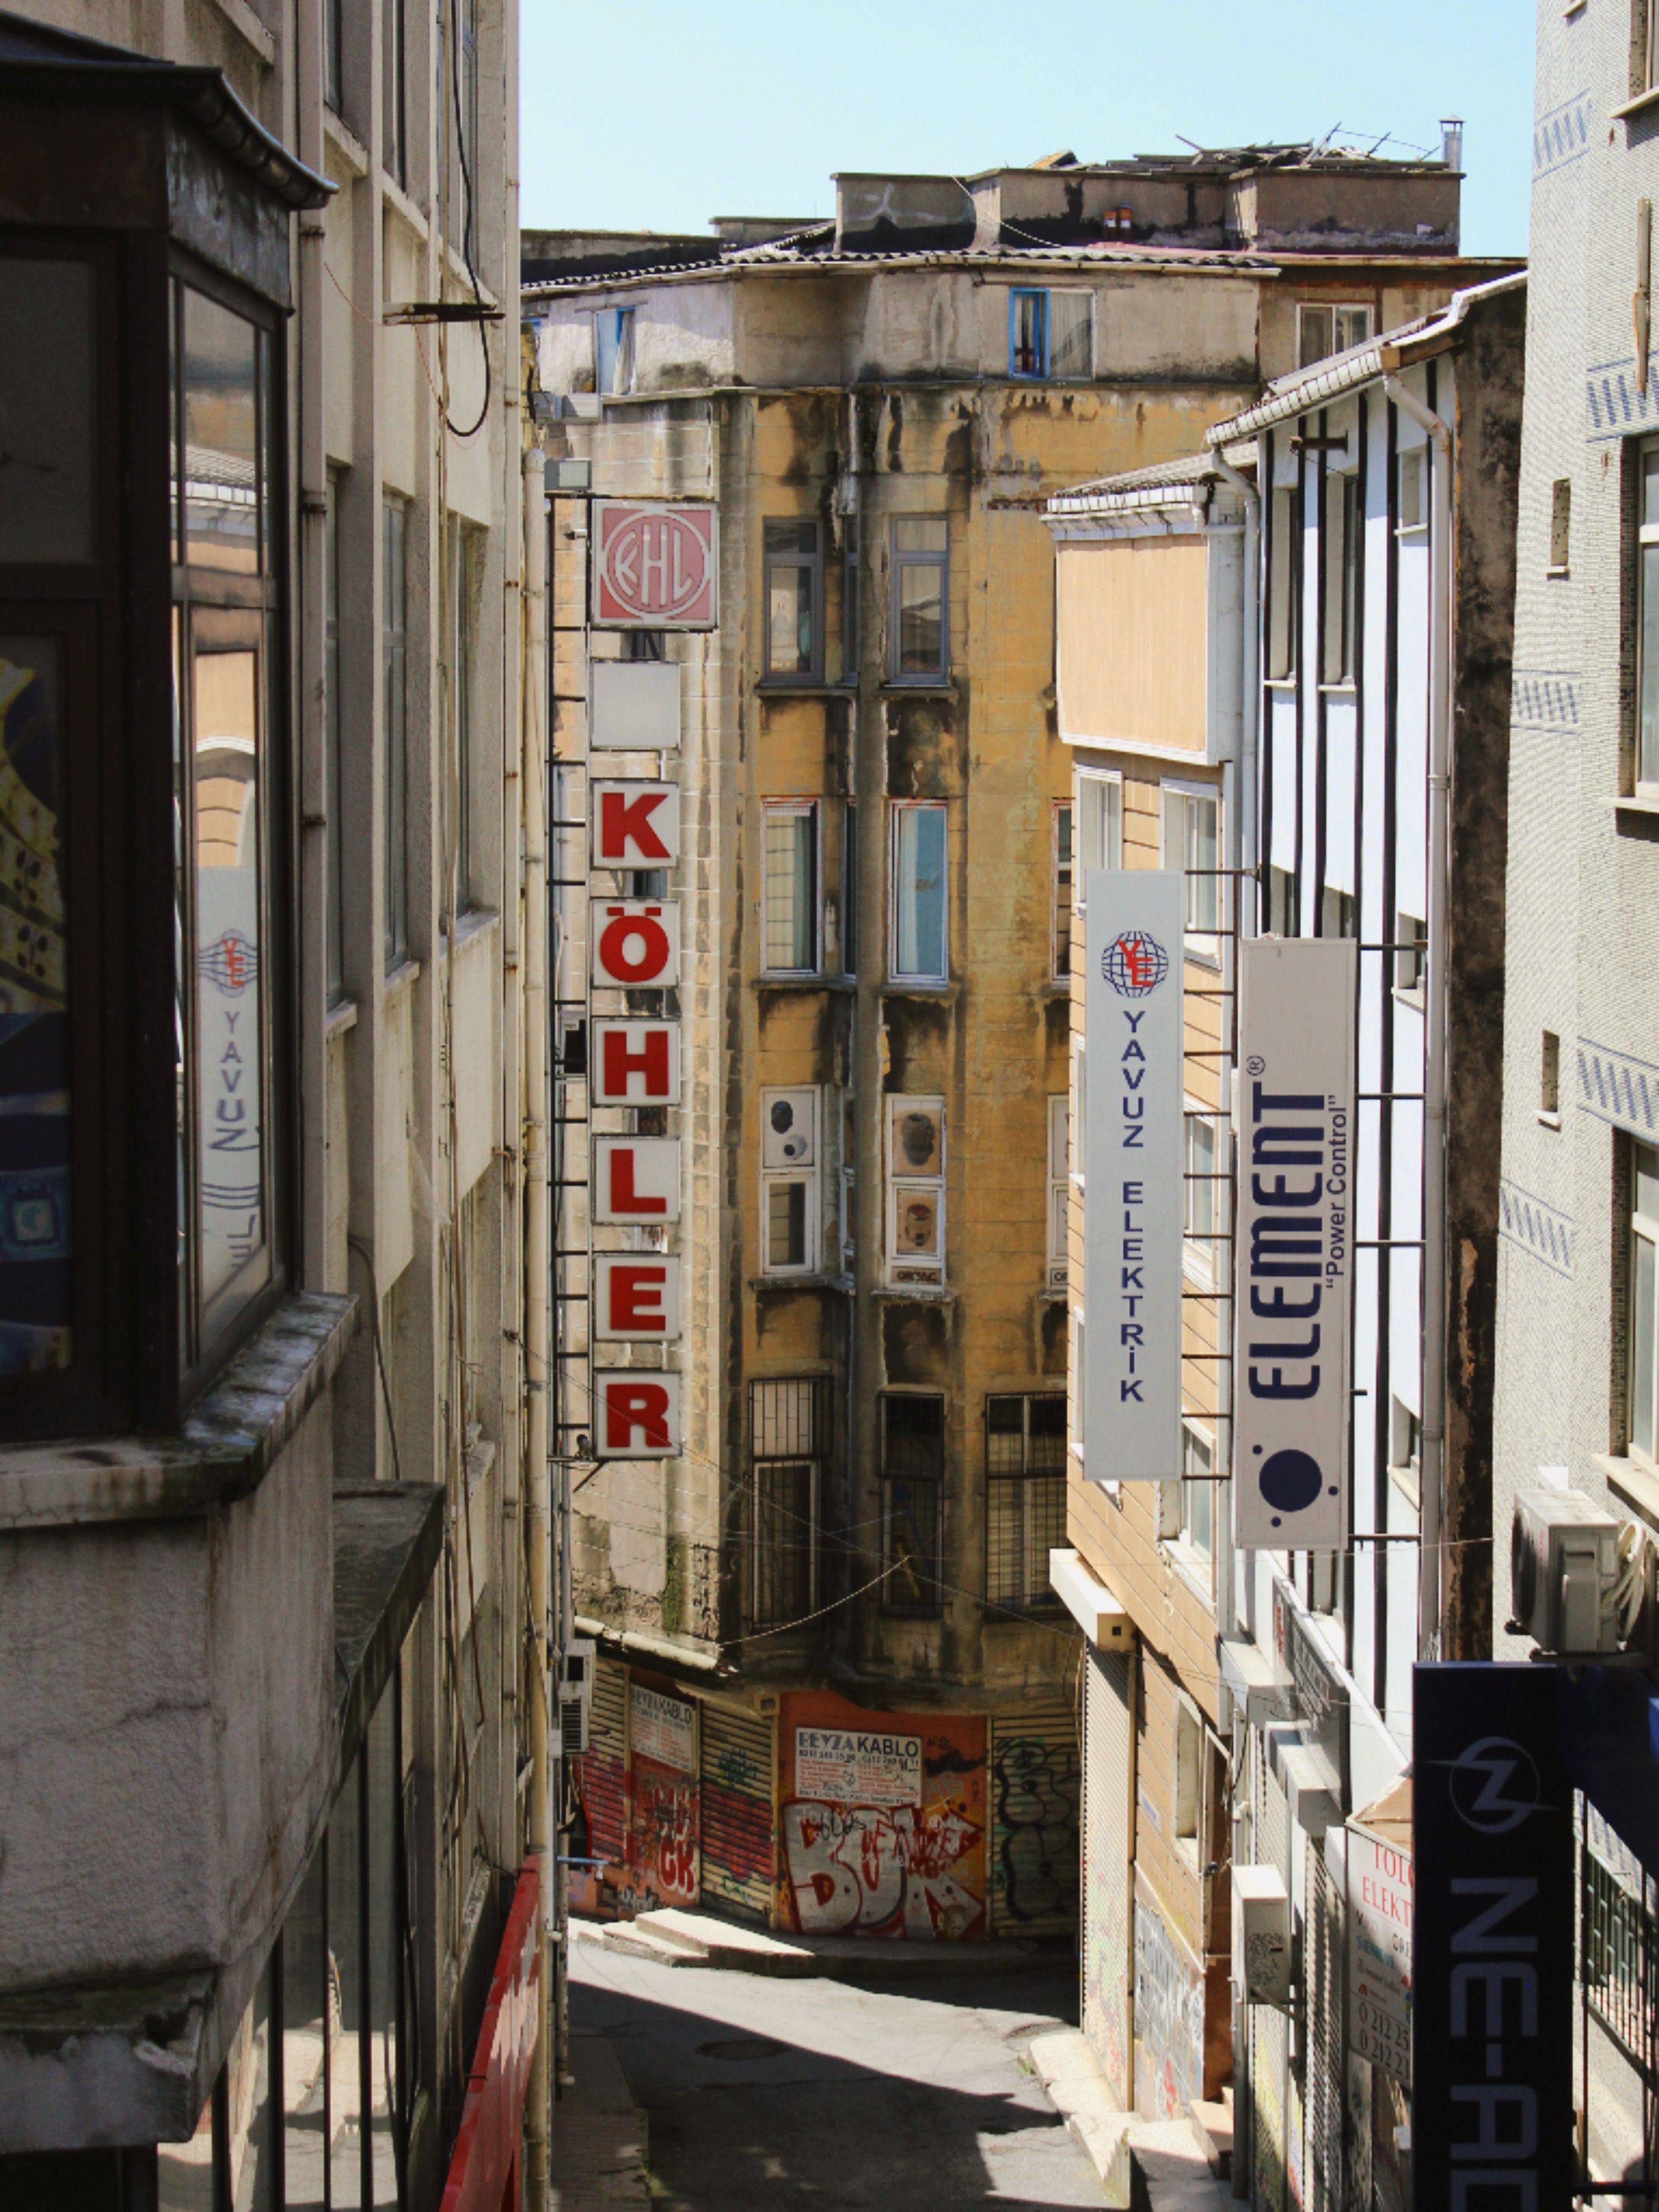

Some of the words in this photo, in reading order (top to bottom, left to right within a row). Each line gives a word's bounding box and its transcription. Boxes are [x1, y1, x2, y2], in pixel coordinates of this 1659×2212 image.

[599, 792, 672, 1448] KÖHLER
[1121, 1010, 1146, 1147] YAVUZ
[799, 1732, 856, 1751] BEYZA
[858, 1736, 919, 1757] KABLO
